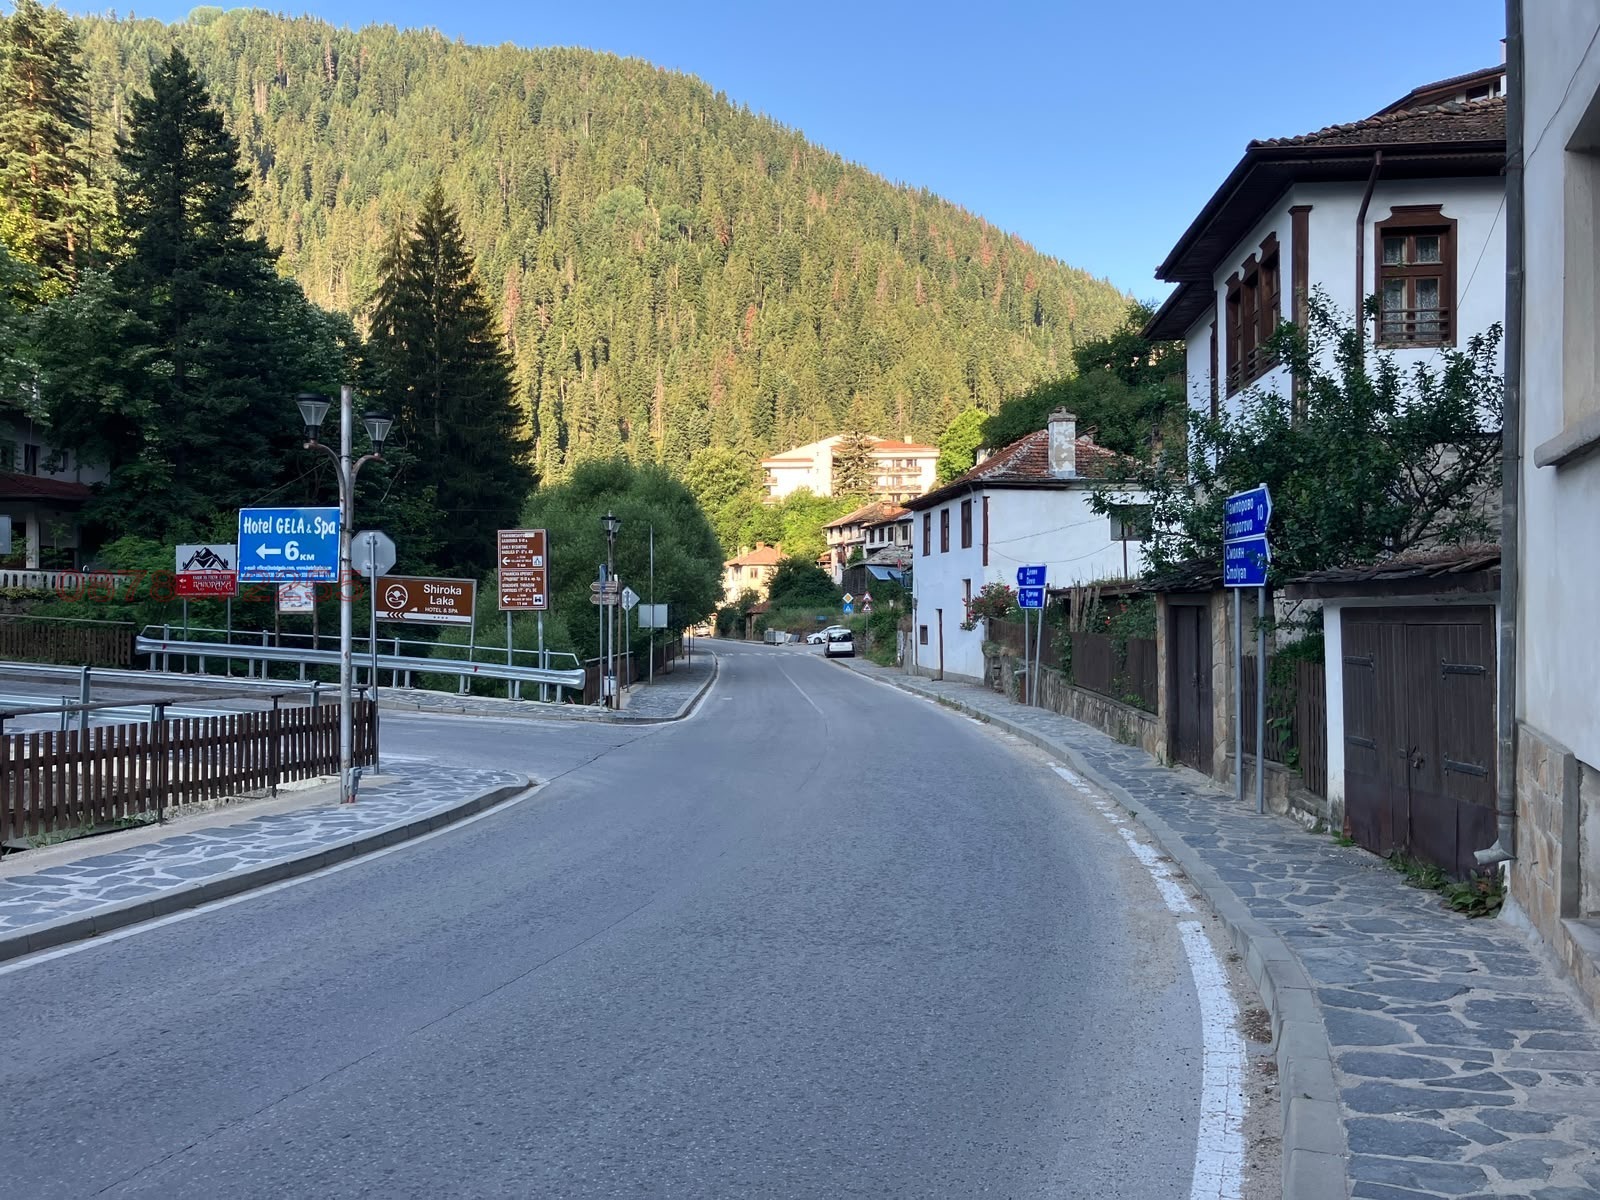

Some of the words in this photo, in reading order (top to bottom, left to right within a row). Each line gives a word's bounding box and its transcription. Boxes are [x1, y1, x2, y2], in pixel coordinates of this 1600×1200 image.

[1225, 497, 1254, 516] Пампорово
[1257, 503, 1264, 521] 10
[243, 515, 272, 534] Hotel
[276, 517, 304, 534] GELA
[306, 524, 312, 533] &
[314, 516, 336, 540] Spa
[1225, 519, 1253, 537] Pamporovo
[284, 540, 300, 561] 6
[1226, 545, 1245, 560] Смолян
[1226, 564, 1247, 583] Smolyan
[423, 583, 462, 595] Shiroka
[430, 595, 454, 606] Laka
